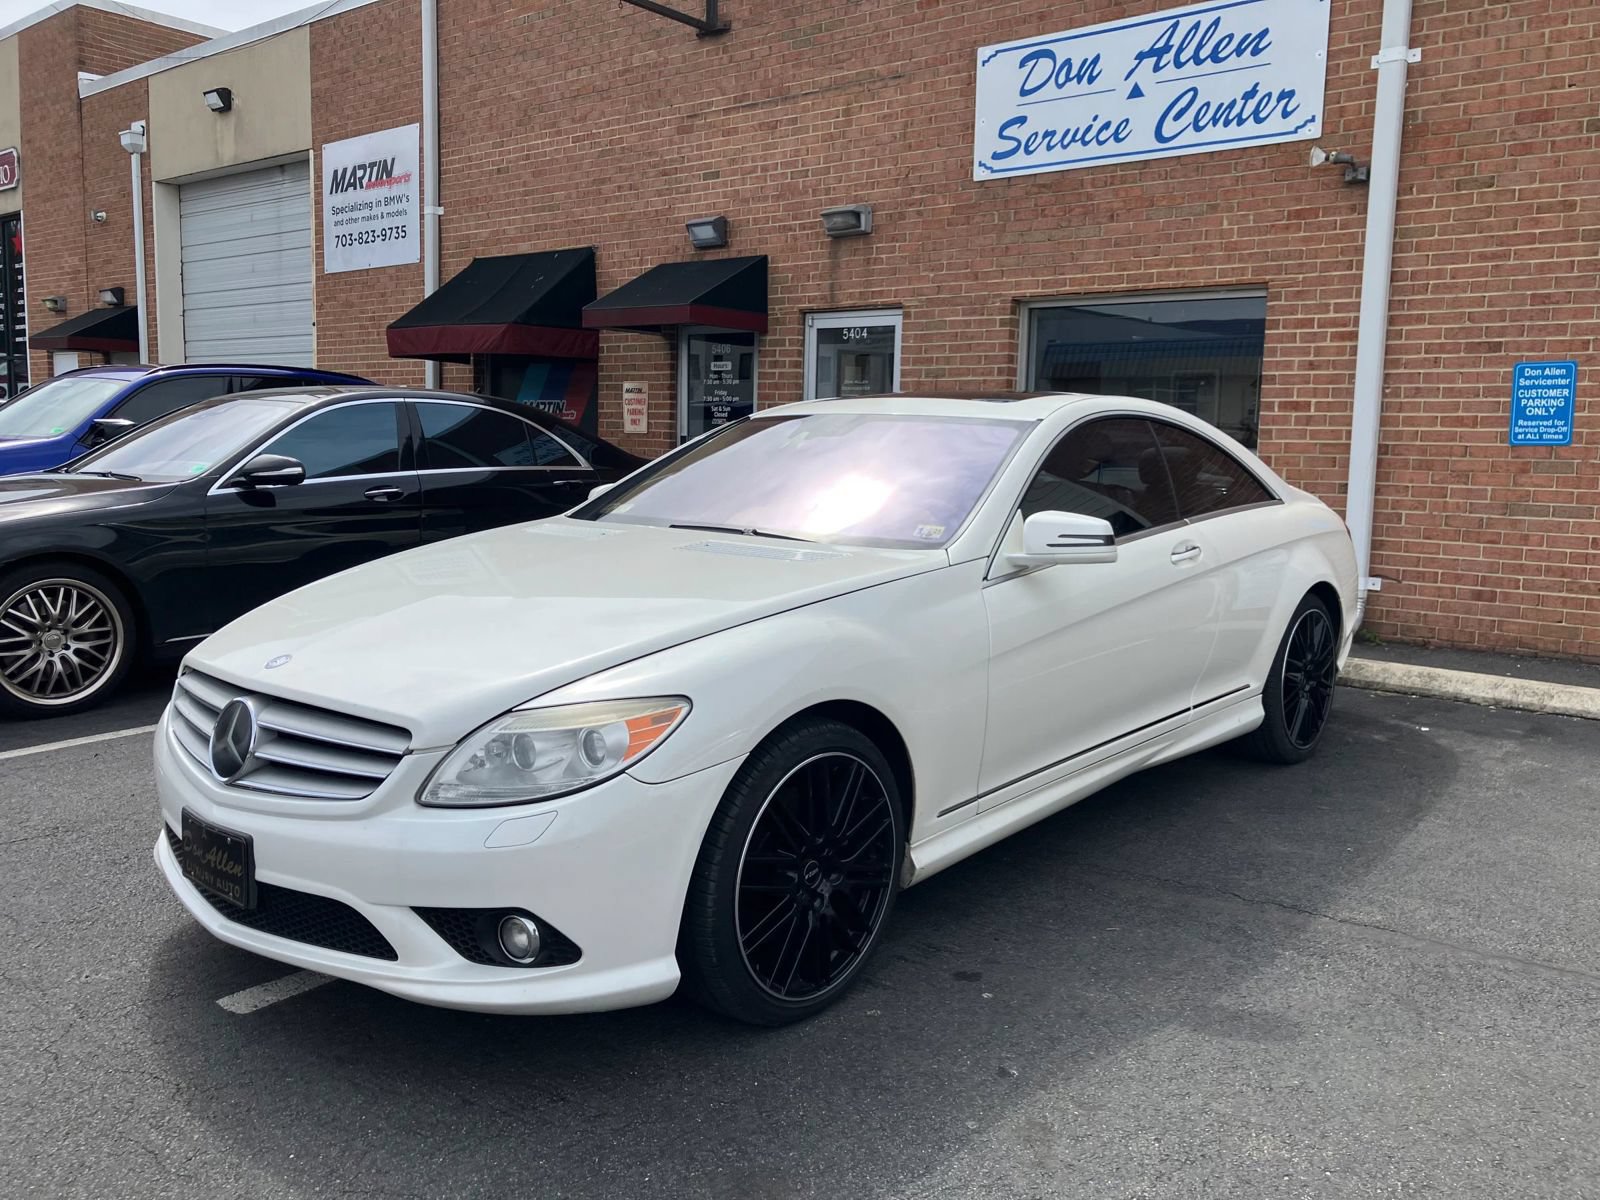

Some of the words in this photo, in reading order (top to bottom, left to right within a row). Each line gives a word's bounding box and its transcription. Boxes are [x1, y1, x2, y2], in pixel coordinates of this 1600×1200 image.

[1018, 48, 1103, 98] Don
[1124, 15, 1272, 82] Allen
[991, 113, 1133, 161] Service
[1154, 81, 1300, 145] Center
[329, 157, 396, 195] MARTIN
[331, 200, 374, 216] Specializing
[375, 197, 382, 208] in
[384, 194, 410, 207] BMW's
[334, 218, 344, 227] and
[345, 215, 360, 226] other
[361, 213, 379, 223] makes
[386, 209, 408, 218] models
[334, 225, 407, 248] 703-823-9735
[842, 327, 868, 340] 5404
[712, 344, 732, 354] 5406
[1524, 368, 1542, 376] Don
[1544, 367, 1566, 376] Allen
[1519, 377, 1570, 386] Servicenter
[1518, 388, 1569, 398] CUSTOMER
[1521, 398, 1565, 407] PARKING
[627, 408, 644, 416] PARKING
[1526, 407, 1556, 415] ONLY
[183, 830, 202, 856] Don
[200, 846, 243, 878] Allen
[216, 878, 240, 898] AUTO
